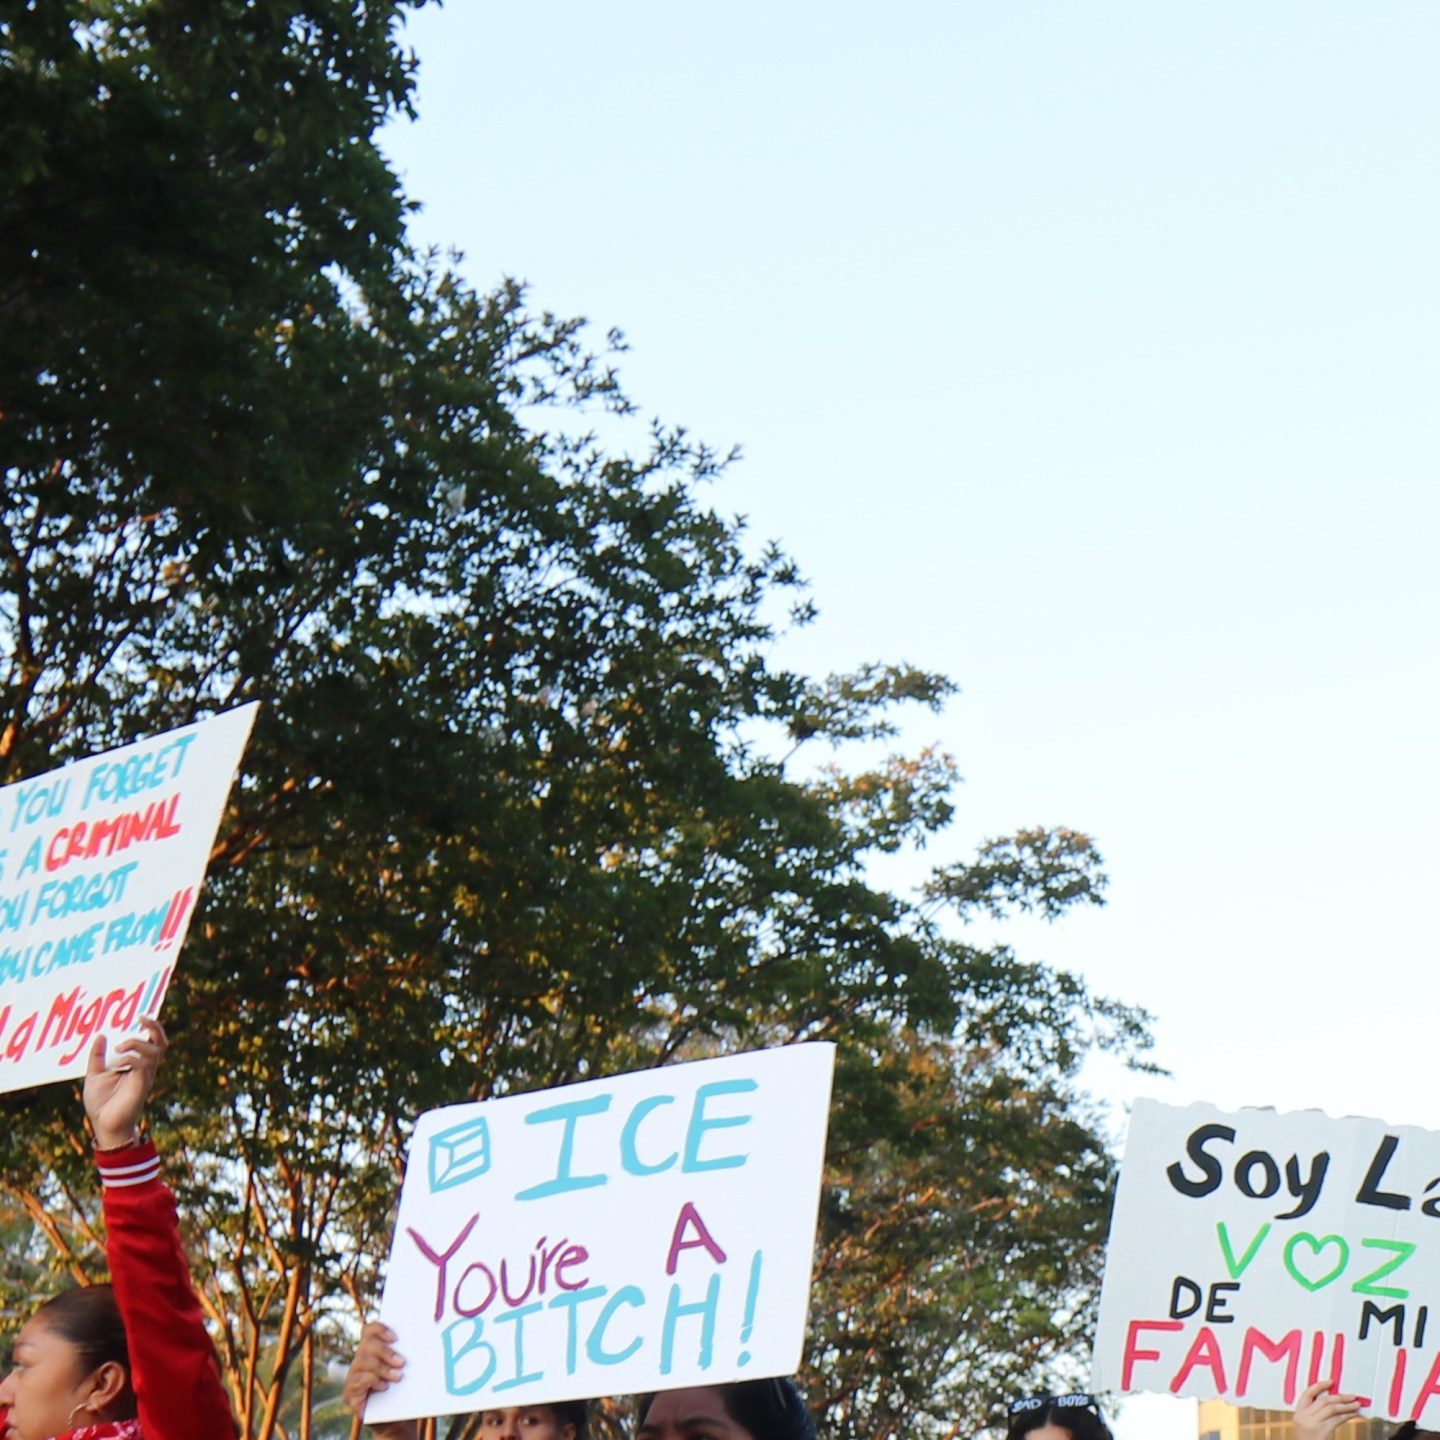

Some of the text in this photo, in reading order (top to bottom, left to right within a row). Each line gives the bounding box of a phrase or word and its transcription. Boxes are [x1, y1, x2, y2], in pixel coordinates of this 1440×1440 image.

[10, 732, 198, 833] YOU FORGET
[16, 835, 42, 880] A
[45, 792, 181, 872] CRIMINAL
[29, 861, 138, 925] FORGOT
[32, 927, 104, 977] CAME
[515, 1078, 758, 1201] ICE
[1167, 1123, 1330, 1220] Soy
[407, 1202, 726, 1322] You're A
[441, 1249, 763, 1396] BITCH!
[1169, 1276, 1428, 1348] DE MI
